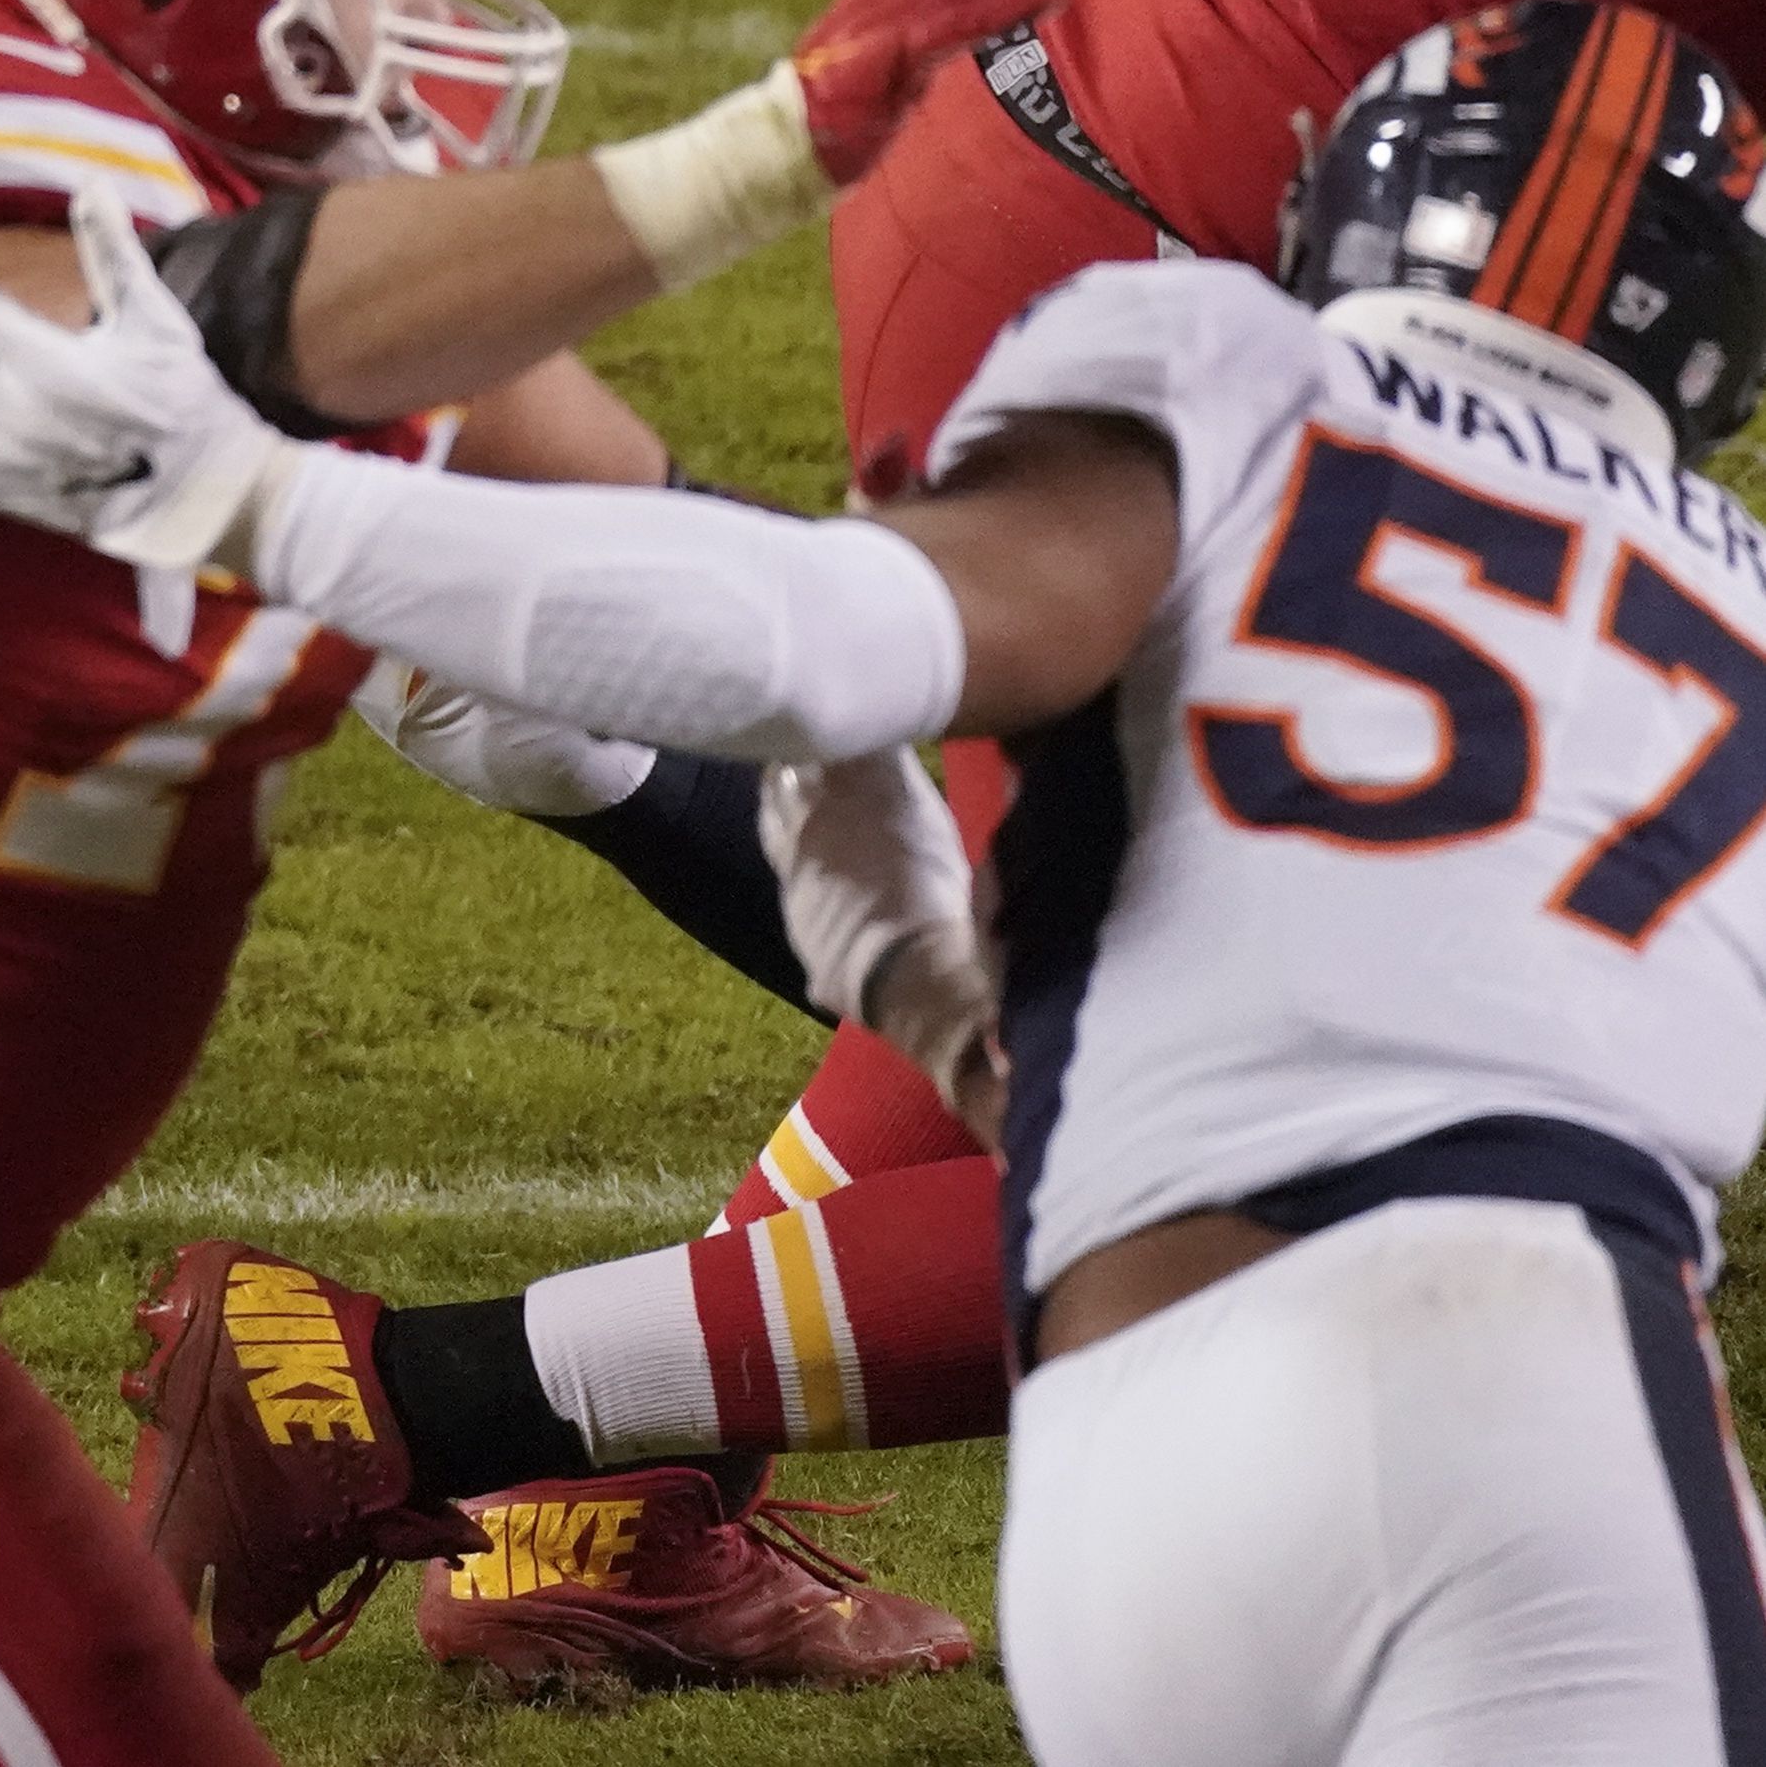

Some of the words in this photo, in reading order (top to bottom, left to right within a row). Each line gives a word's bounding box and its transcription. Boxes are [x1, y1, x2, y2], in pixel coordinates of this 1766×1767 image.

[1343, 336, 1766, 596] WALKER
[1184, 420, 1766, 958] 57
[223, 1261, 377, 1446] NIKE
[451, 1499, 646, 1601] NIKE
